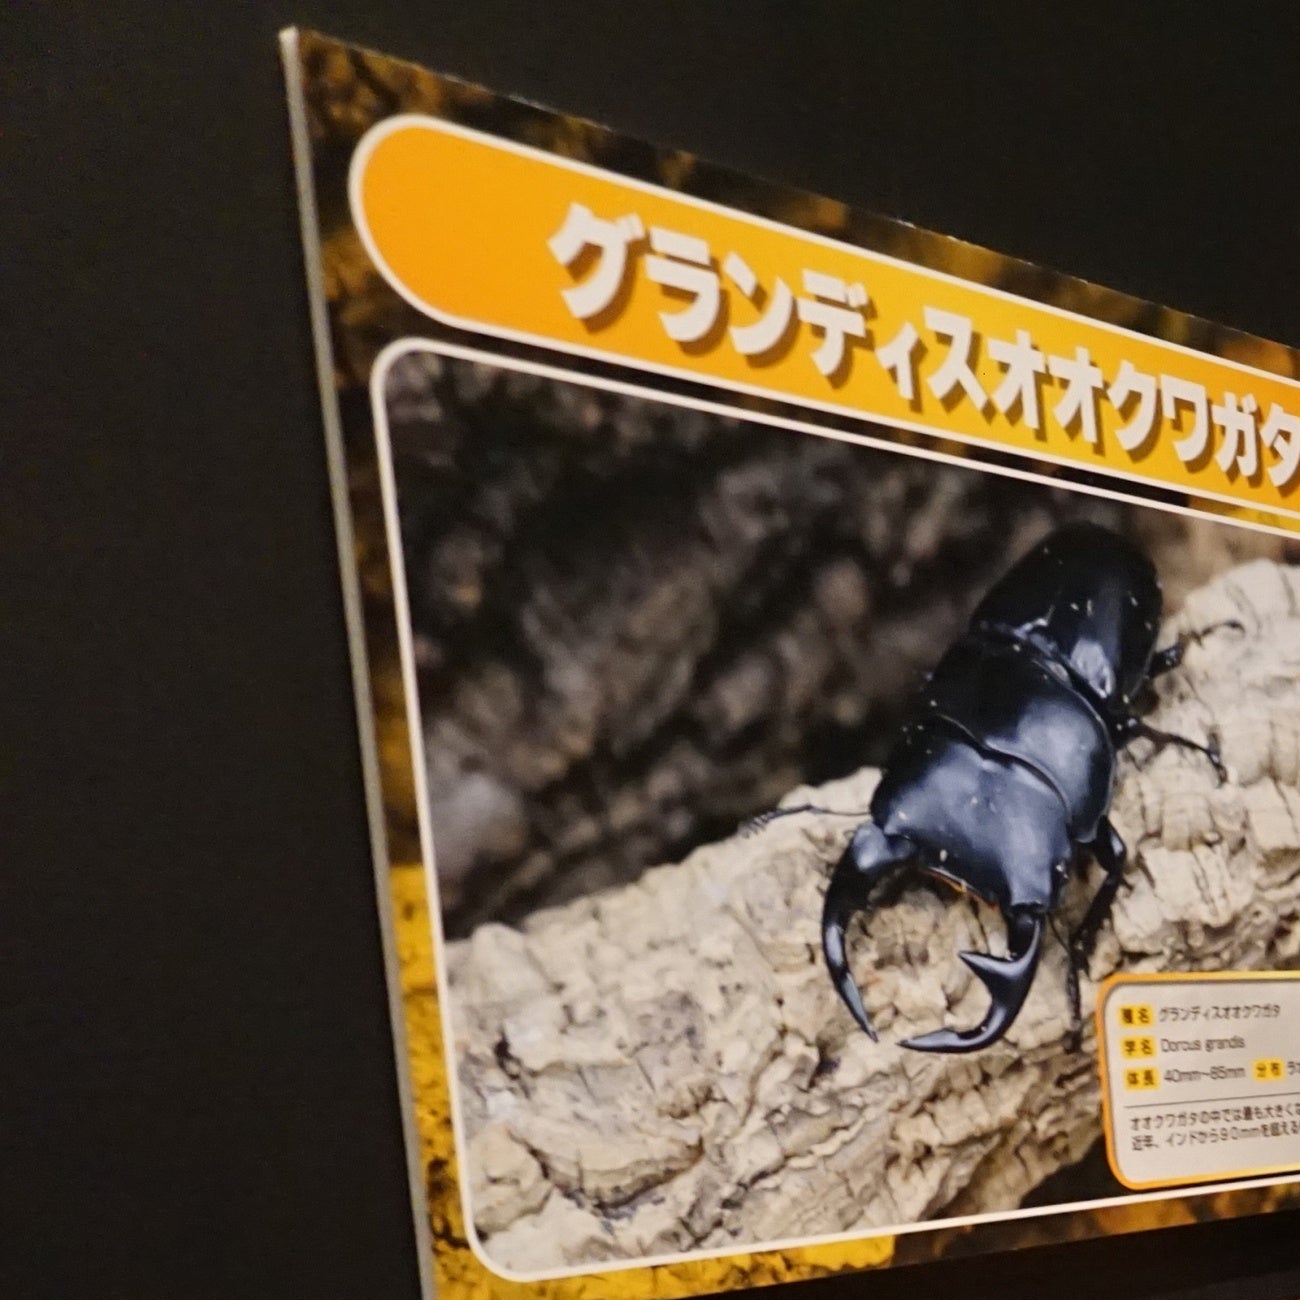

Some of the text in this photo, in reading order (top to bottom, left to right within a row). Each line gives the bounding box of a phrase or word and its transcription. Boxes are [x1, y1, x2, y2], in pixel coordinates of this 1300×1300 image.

[1159, 1004, 1281, 1022] グランディスオオクワガタ
[1160, 1038, 1202, 1053] Dorcus
[1205, 1035, 1246, 1052] grandis
